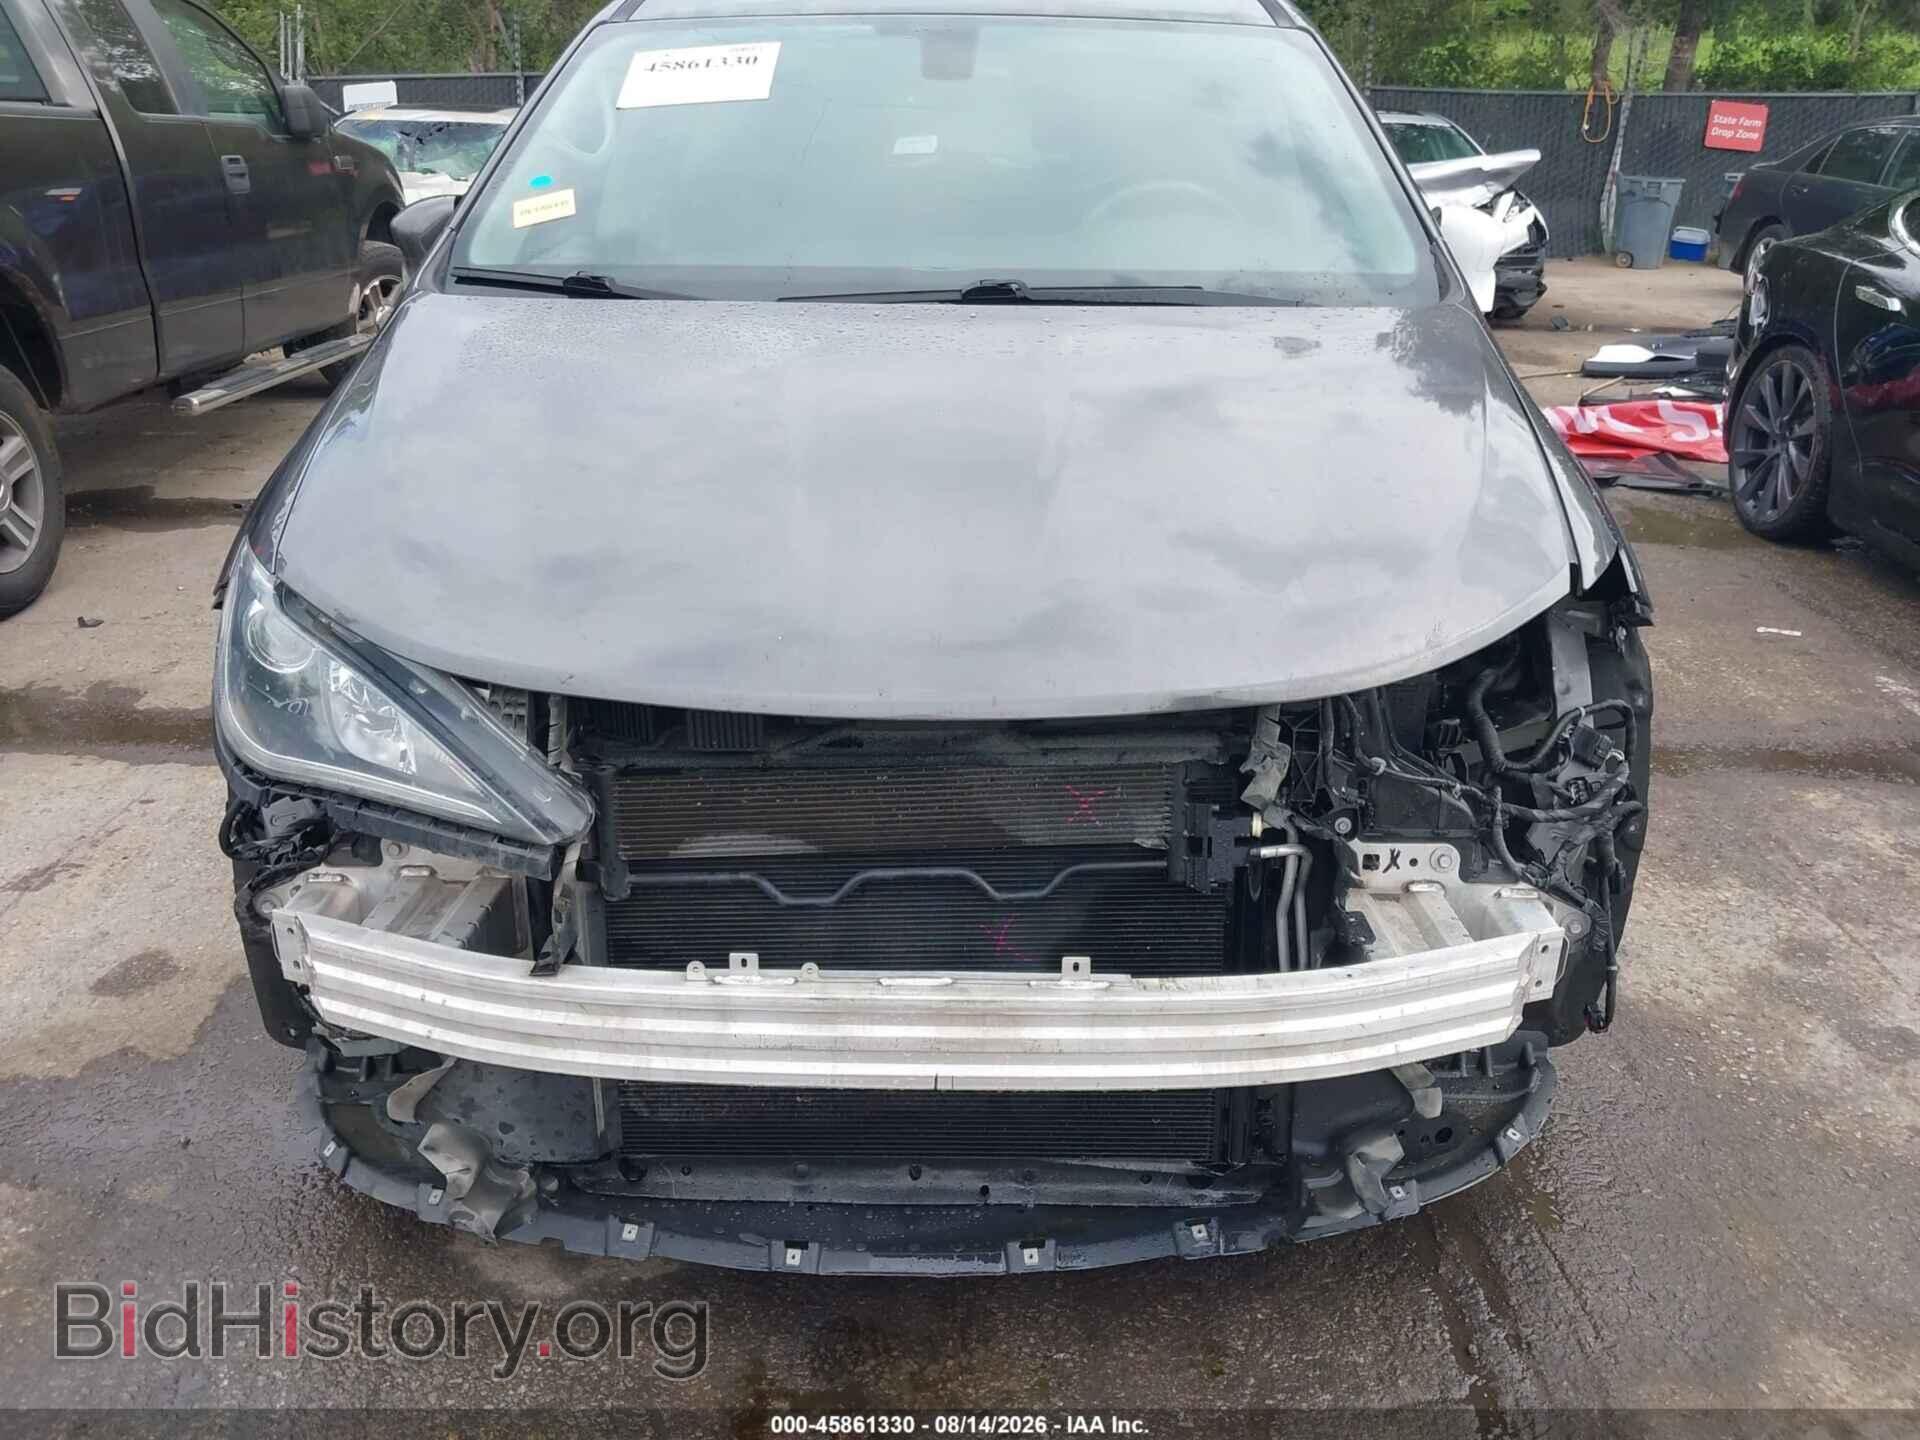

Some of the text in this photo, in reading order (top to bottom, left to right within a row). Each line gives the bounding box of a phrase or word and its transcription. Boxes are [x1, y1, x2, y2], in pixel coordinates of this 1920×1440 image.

[1713, 114, 1762, 127] State Farm
[1711, 127, 1760, 140] Drop Zone
